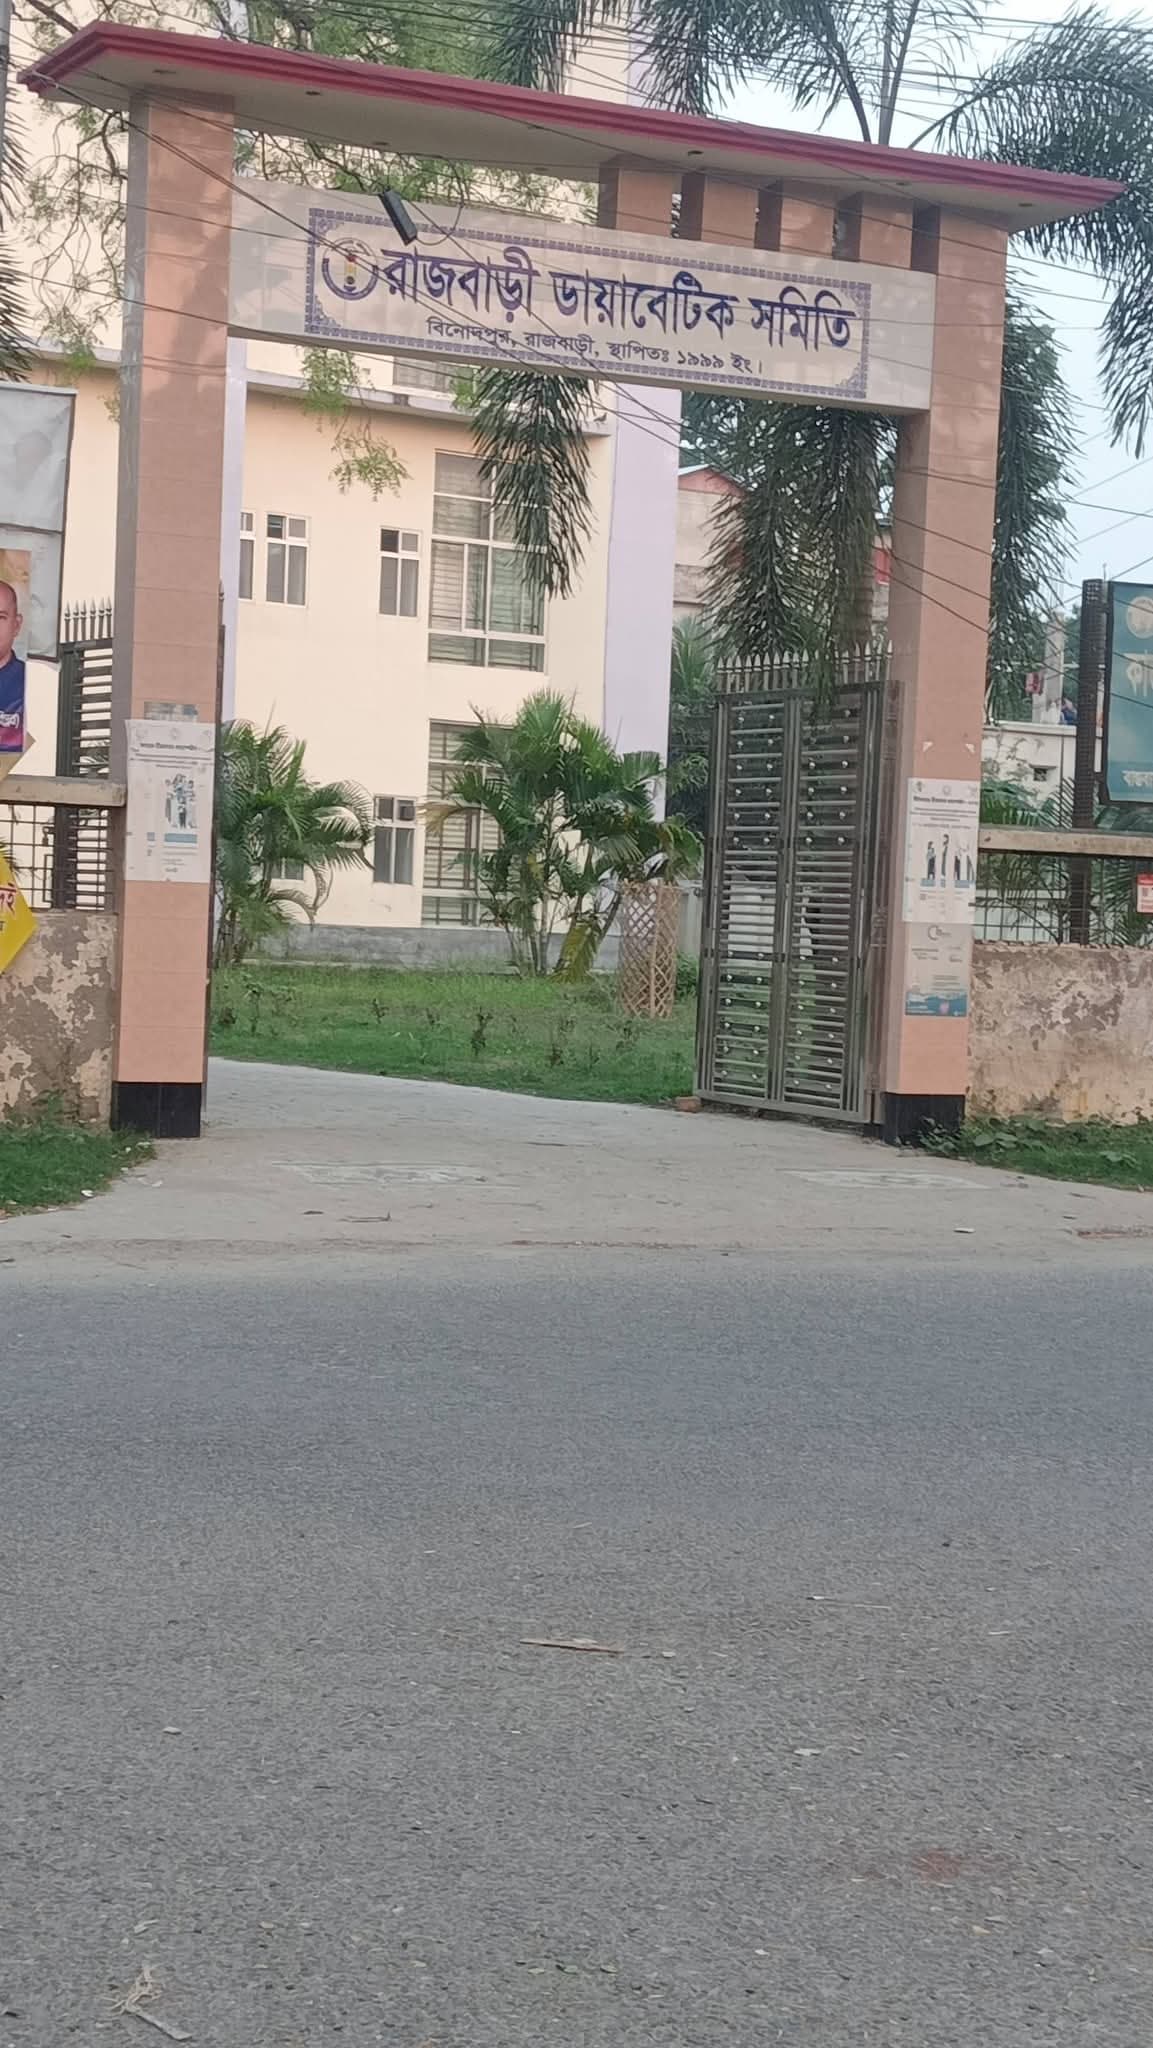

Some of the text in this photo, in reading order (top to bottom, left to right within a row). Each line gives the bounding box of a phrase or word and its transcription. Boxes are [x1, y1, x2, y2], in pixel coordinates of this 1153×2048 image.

[380, 246, 856, 351] রাজবাড়ী ডায়াবেটিক সমিতি
[677, 349, 725, 369] ১৯৯৯
